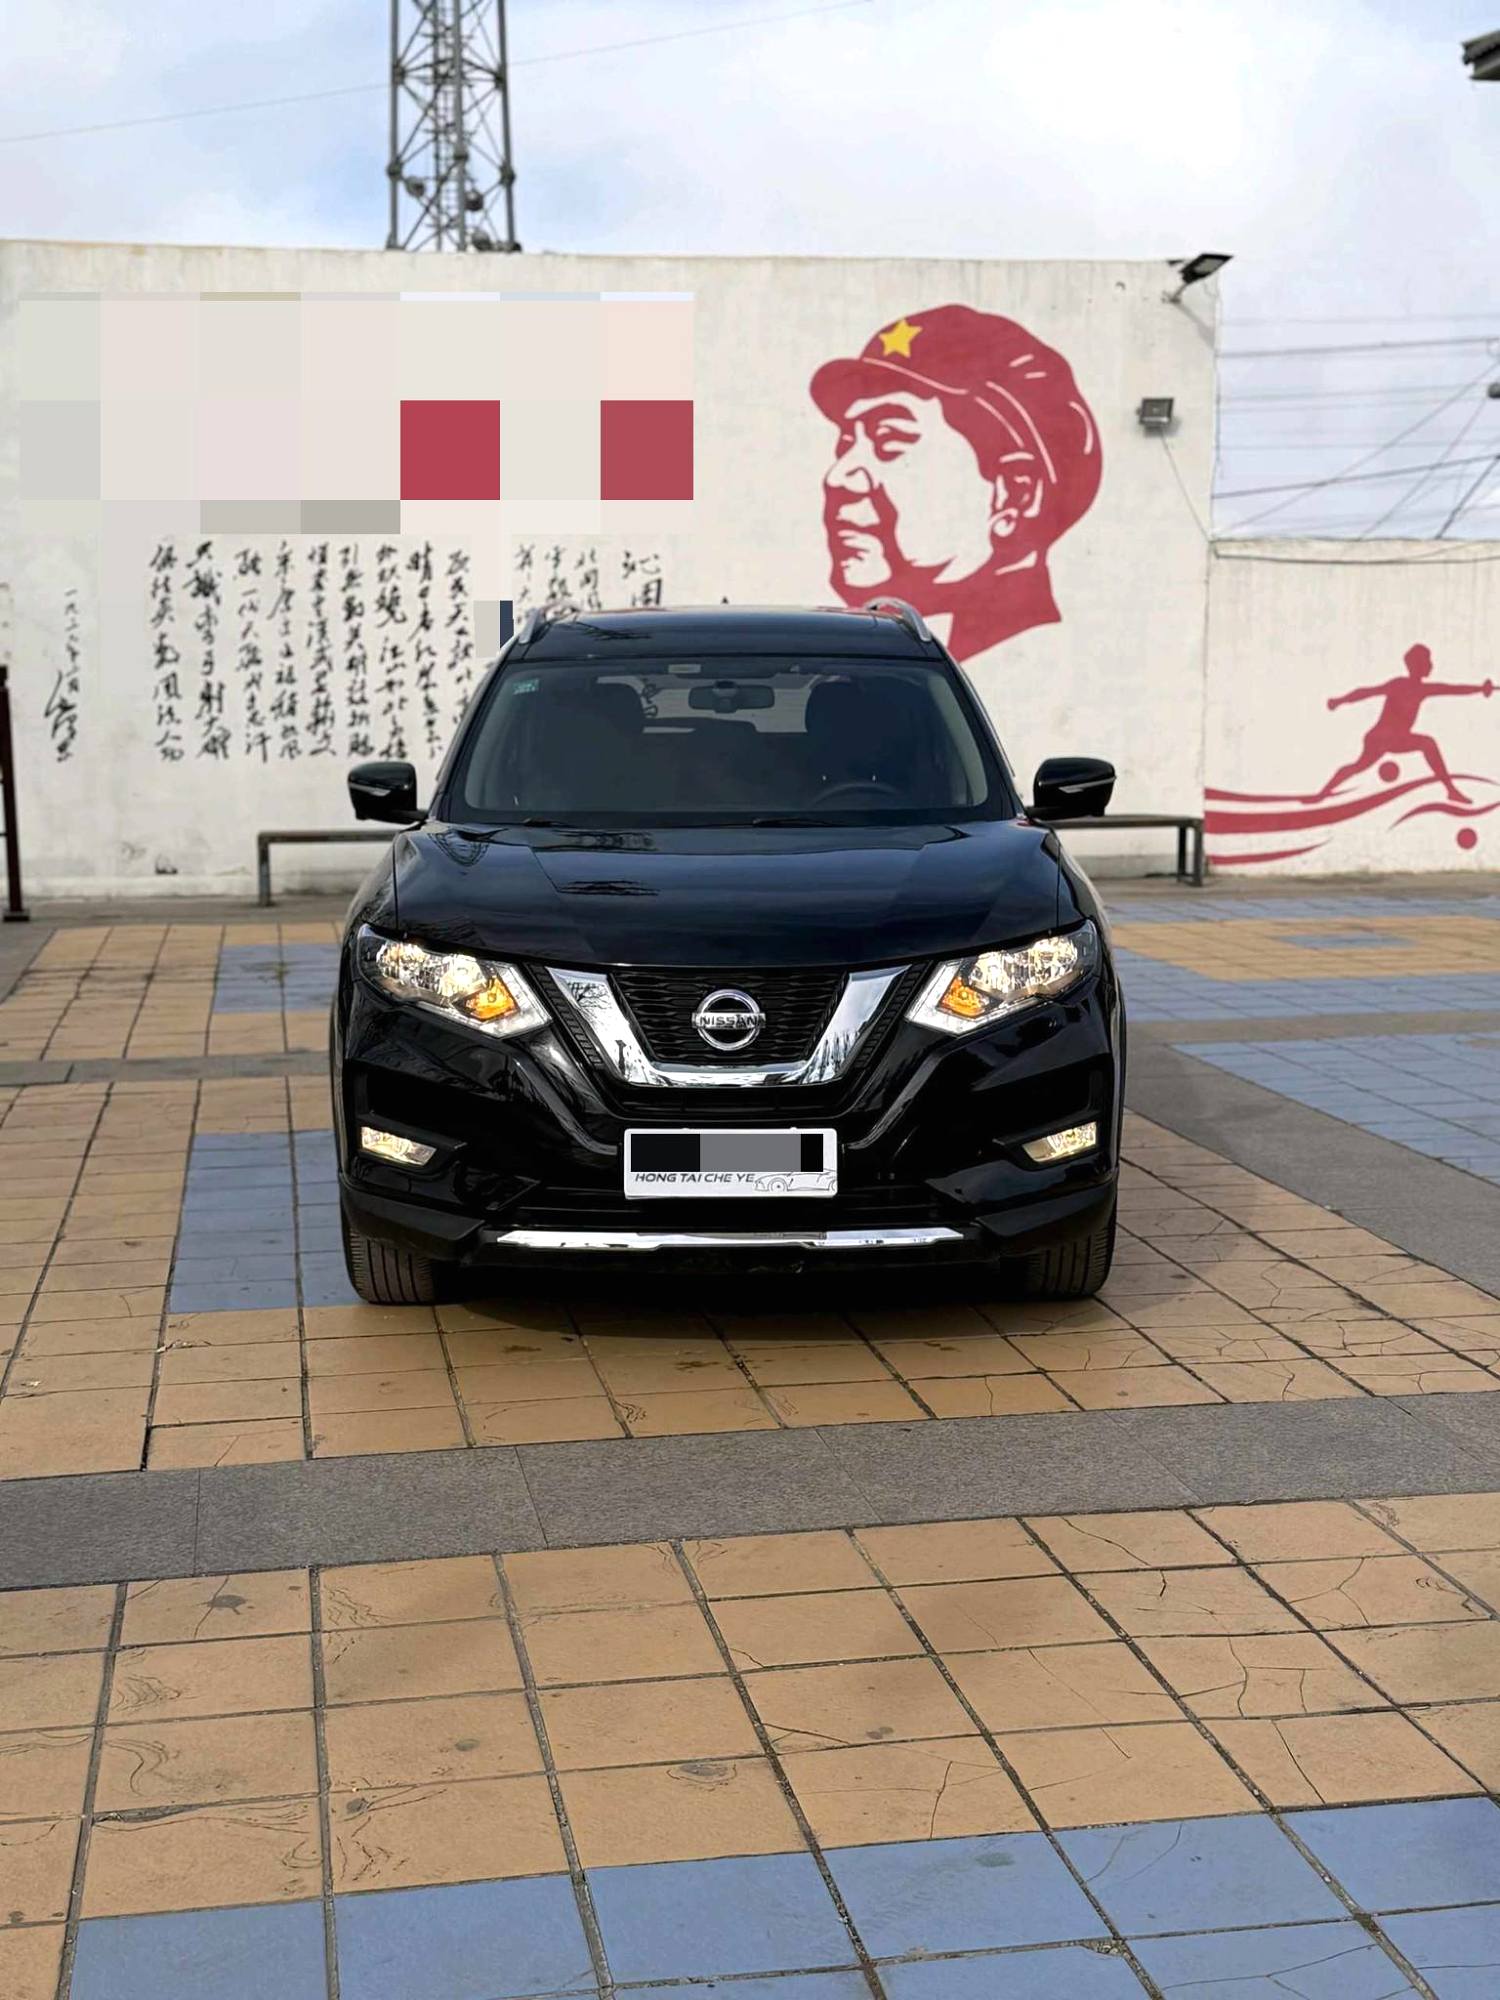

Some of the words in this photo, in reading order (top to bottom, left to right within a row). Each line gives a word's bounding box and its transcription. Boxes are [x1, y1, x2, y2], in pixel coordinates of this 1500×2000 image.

[700, 1014, 759, 1028] NISSAN
[635, 1172, 677, 1183] HONG
[681, 1172, 702, 1183] TAI
[704, 1172, 732, 1183] CHE
[735, 1172, 756, 1183] YE
